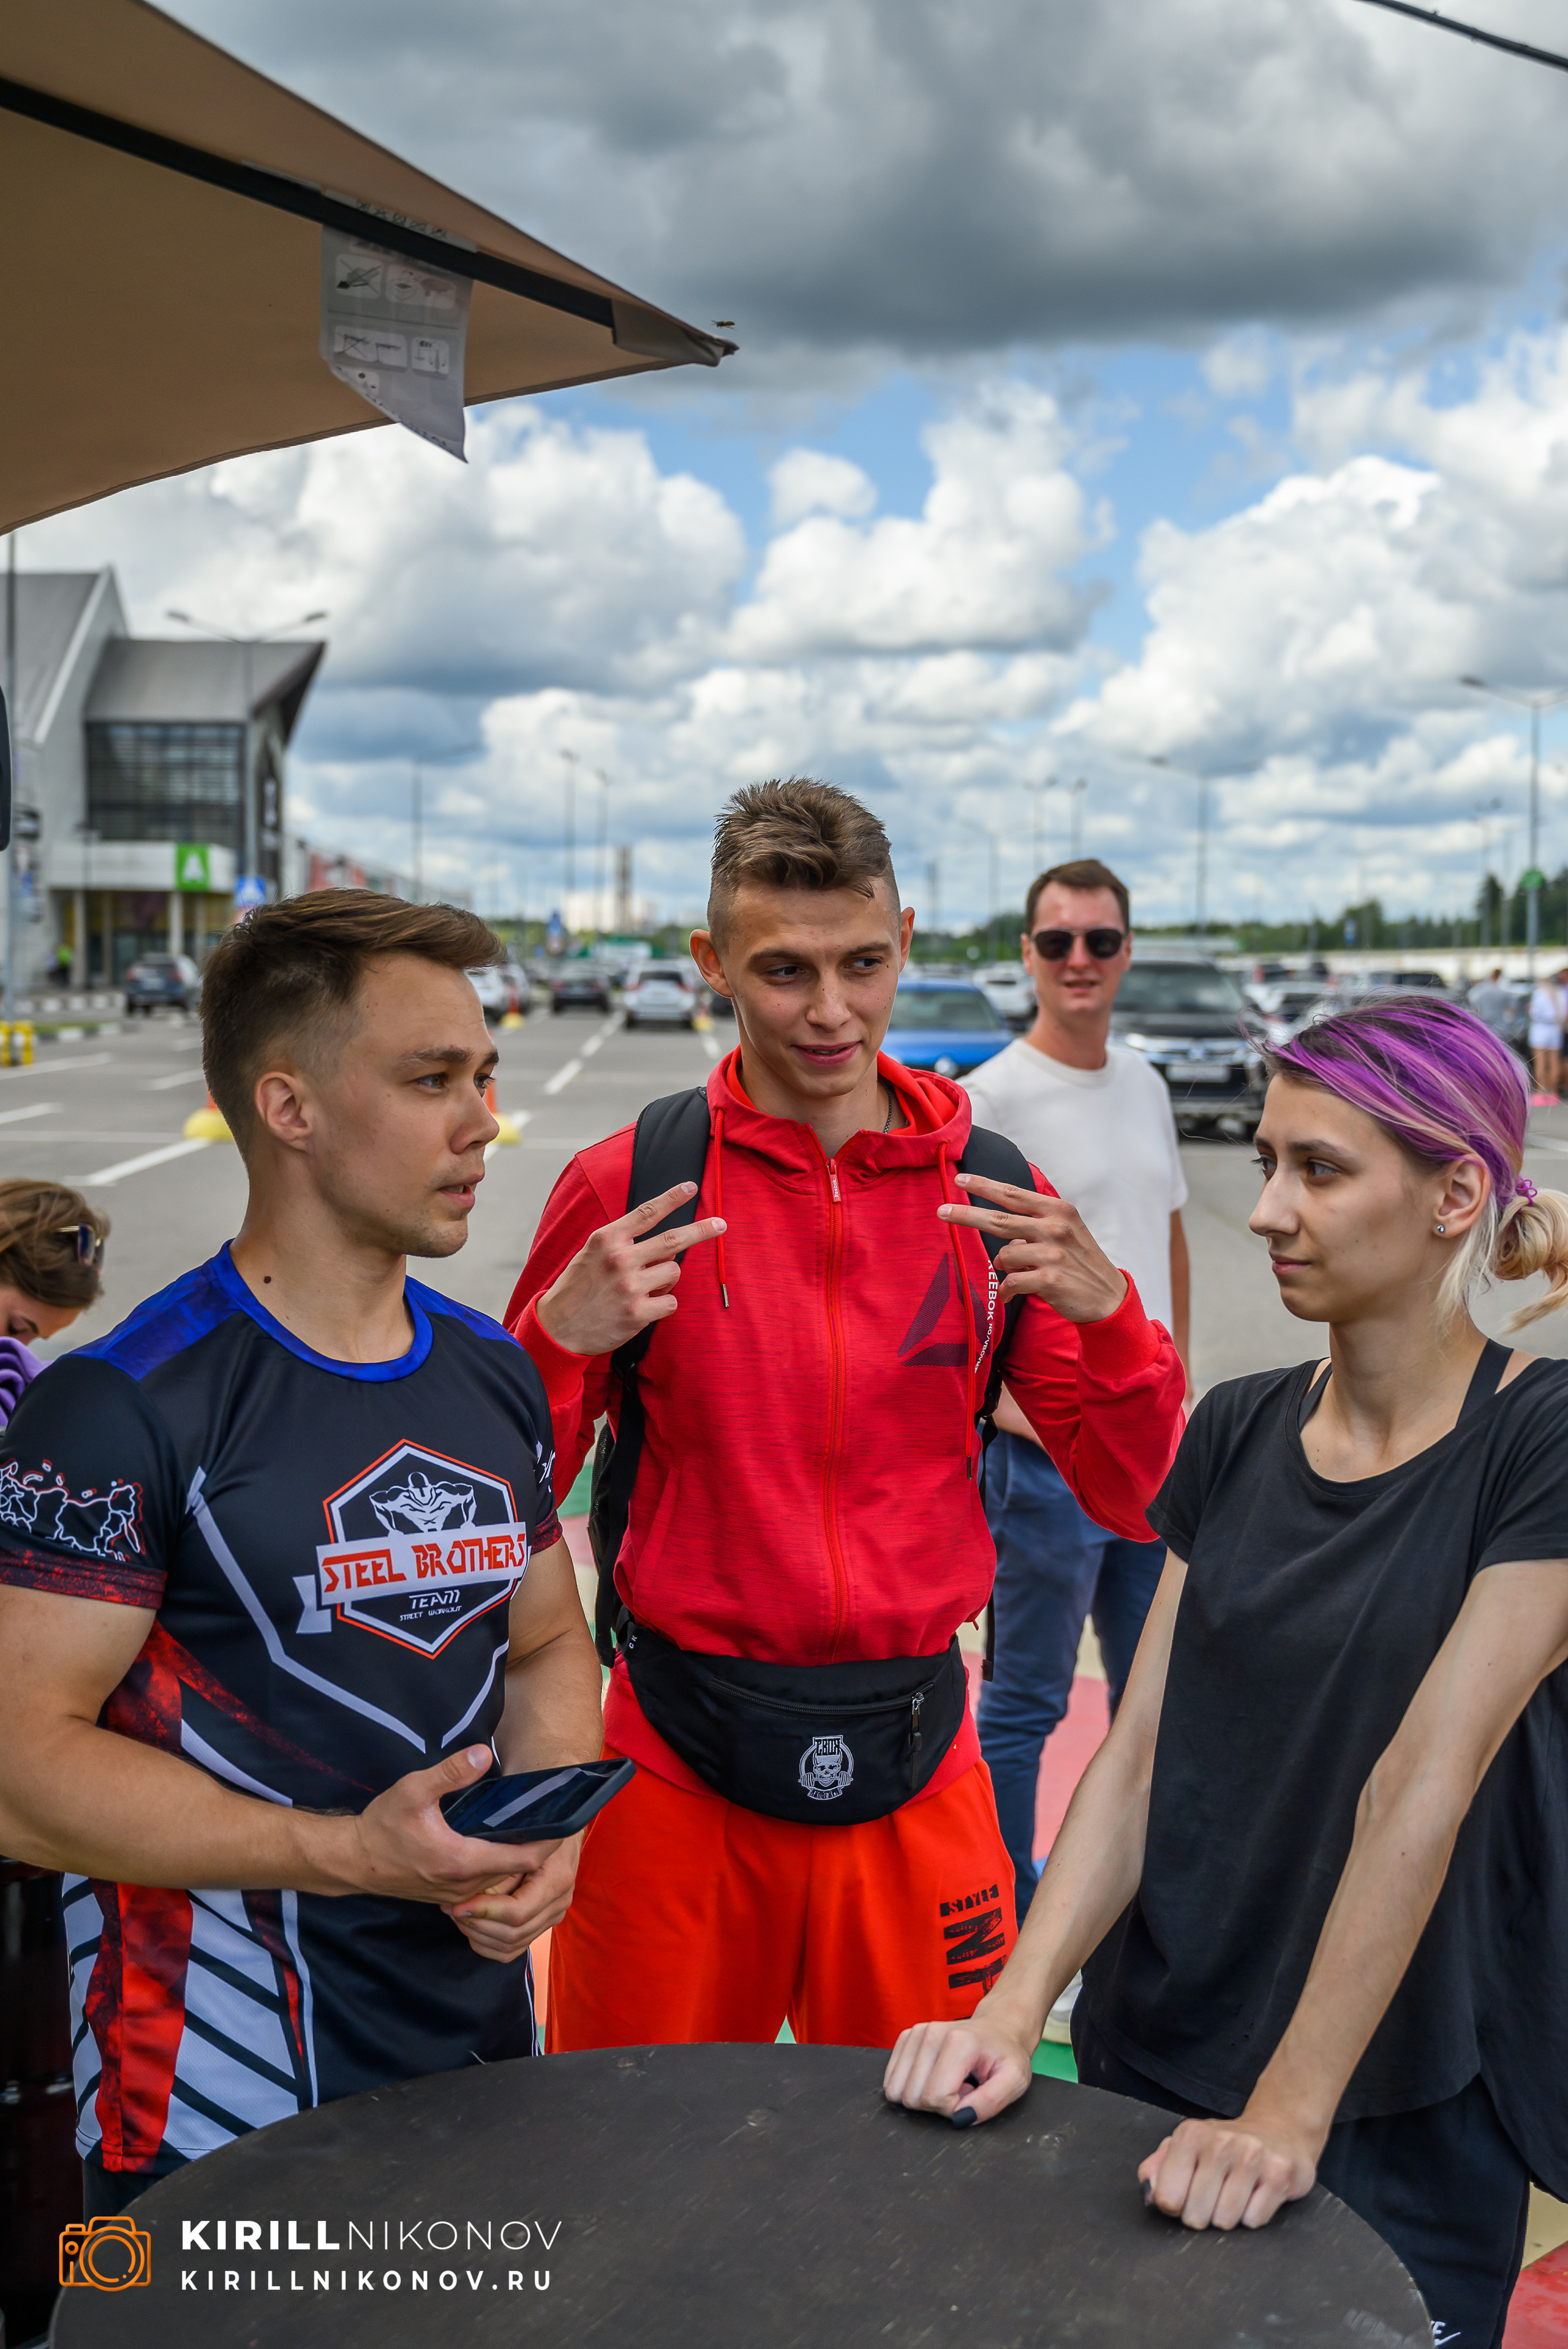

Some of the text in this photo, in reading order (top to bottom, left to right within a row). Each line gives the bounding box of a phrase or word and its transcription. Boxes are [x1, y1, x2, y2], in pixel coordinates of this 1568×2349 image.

[322, 1533, 526, 1593] STEEL BROTHERS
[409, 1589, 461, 1610] TEAM
